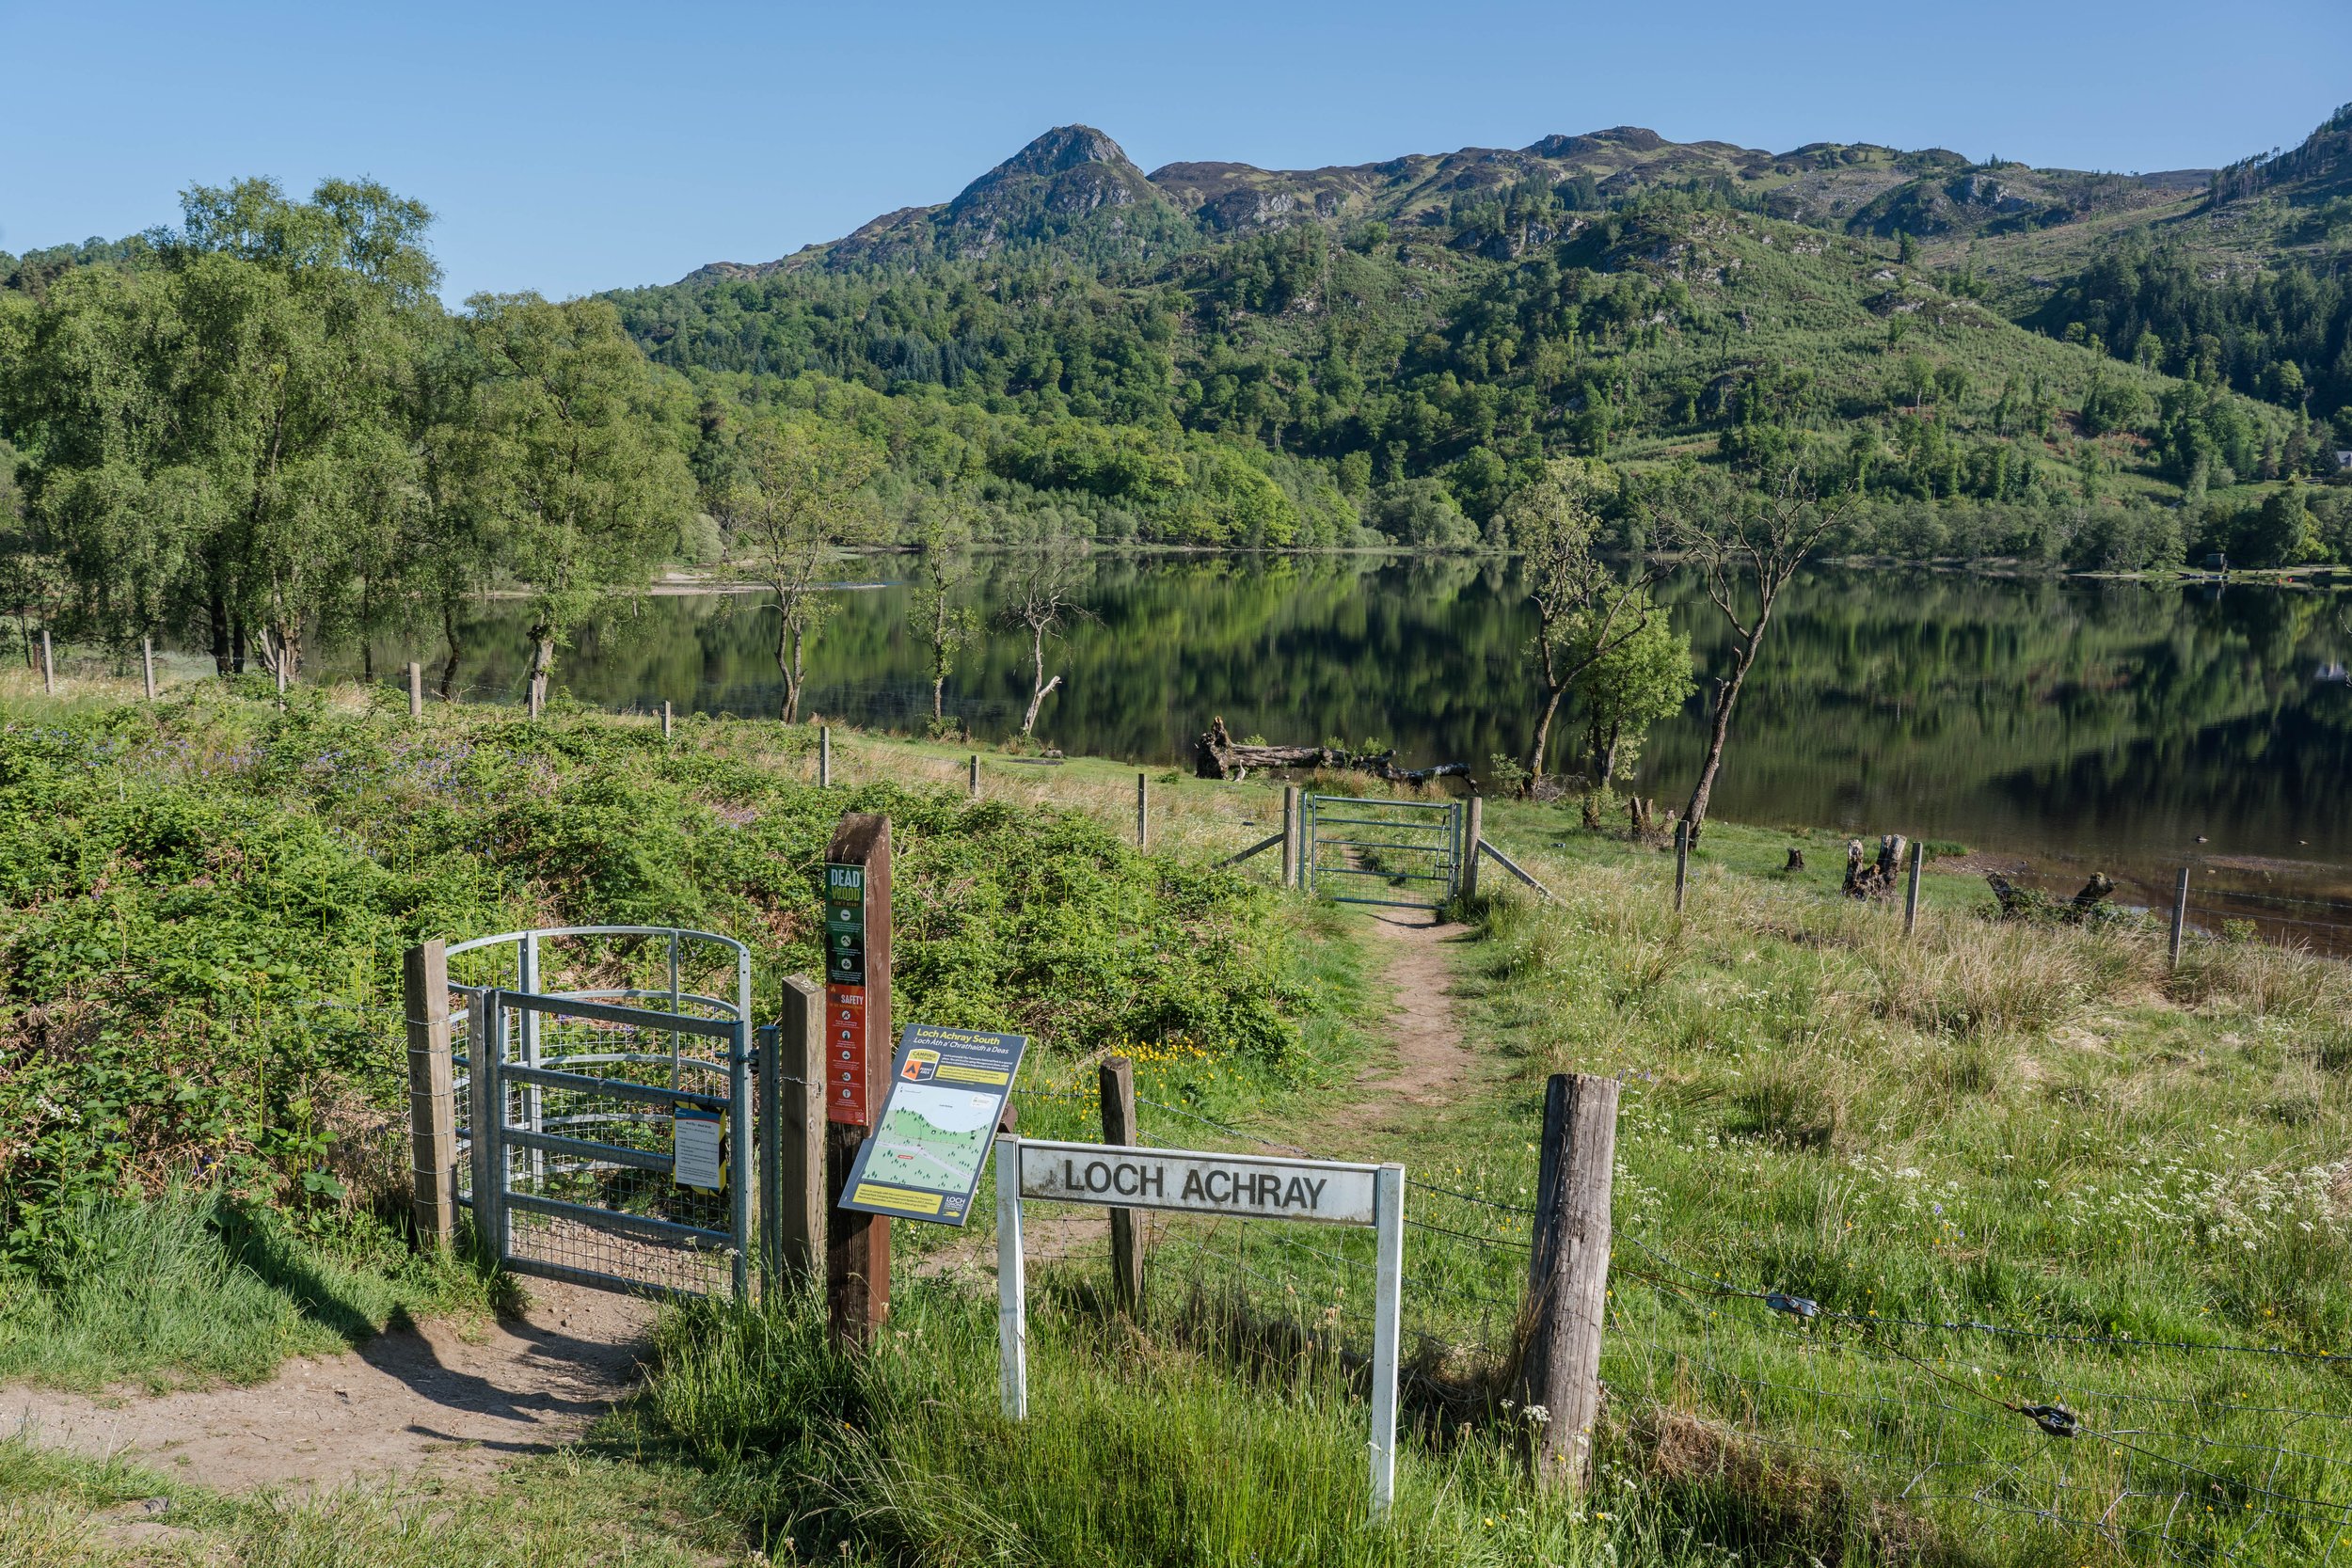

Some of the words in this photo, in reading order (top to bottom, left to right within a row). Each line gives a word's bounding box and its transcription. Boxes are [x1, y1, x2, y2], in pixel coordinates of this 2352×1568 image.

[831, 868, 861, 888] DEAD
[832, 886, 860, 901] WOOD
[840, 994, 864, 1006] SAFETY
[916, 1028, 939, 1038] Loch
[939, 1031, 973, 1044] Achray
[973, 1035, 1000, 1045] South
[914, 1037, 930, 1045] Loch
[949, 1041, 986, 1052] Chrathaidh
[991, 1046, 1009, 1054] Deas
[1065, 1159, 1164, 1197] LOCH
[1180, 1168, 1327, 1210] ACHRAY
[946, 1196, 966, 1204] LOCH
